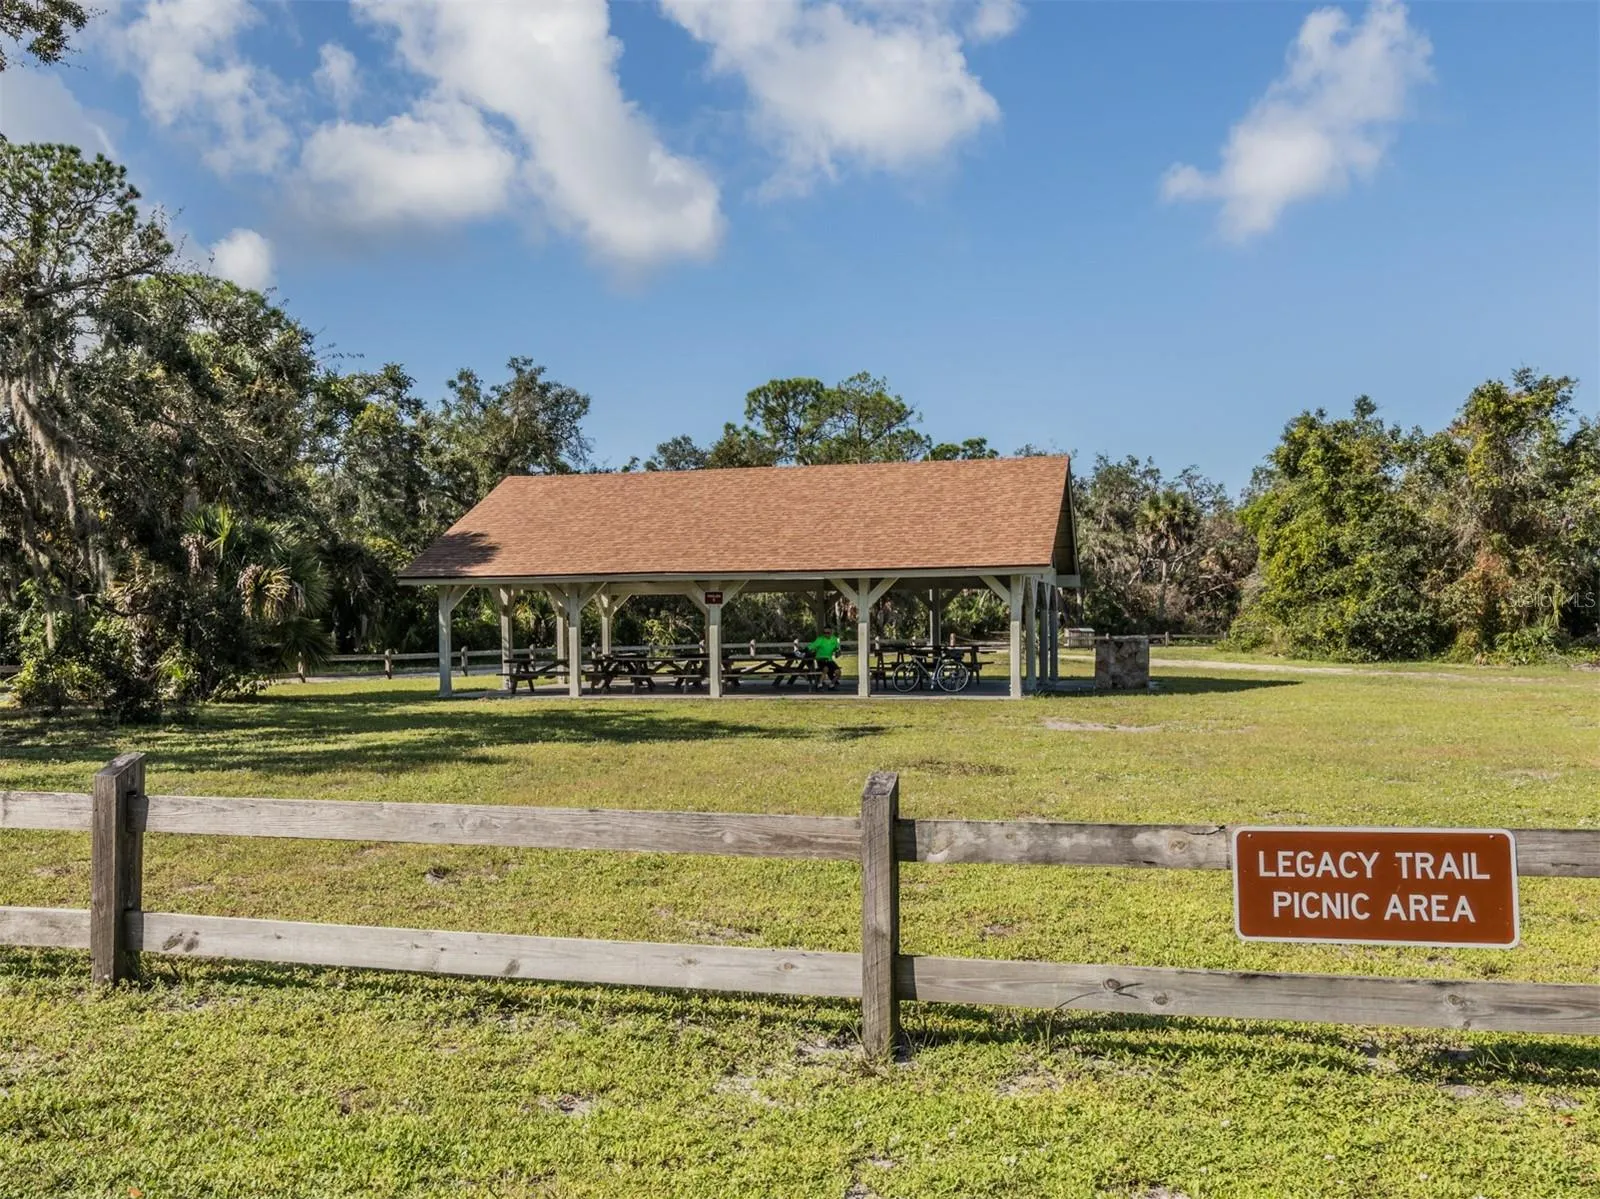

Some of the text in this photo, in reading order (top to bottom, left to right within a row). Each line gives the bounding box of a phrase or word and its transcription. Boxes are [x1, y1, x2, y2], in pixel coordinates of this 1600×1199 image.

[1258, 850, 1491, 880] LEGACY TRAIL
[1272, 891, 1476, 923] PICNIC AREA
